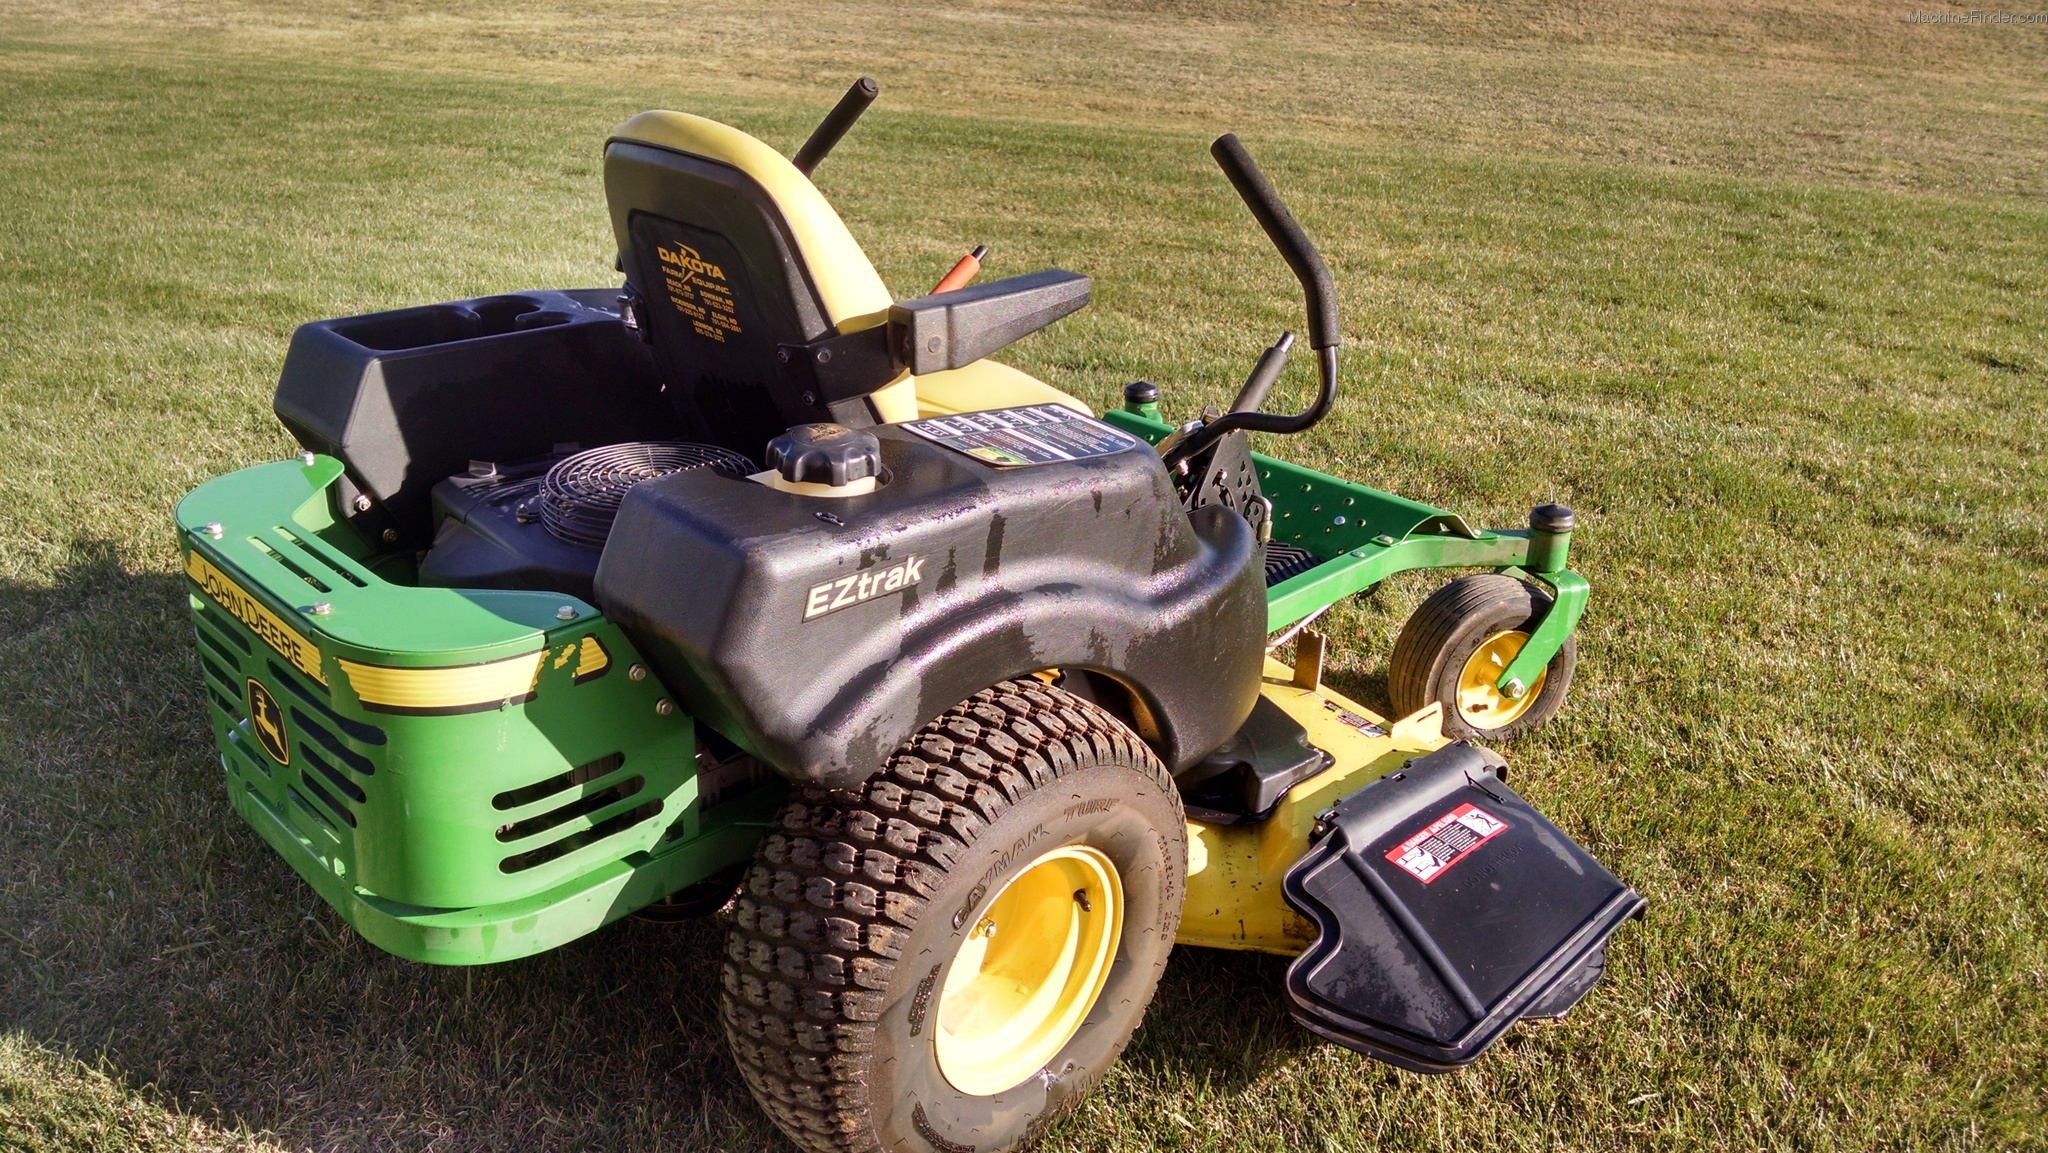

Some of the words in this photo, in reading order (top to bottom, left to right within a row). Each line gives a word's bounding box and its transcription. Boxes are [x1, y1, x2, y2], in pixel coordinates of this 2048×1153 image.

[657, 246, 726, 281] DAKOTA
[662, 265, 685, 279] FARM
[805, 556, 925, 618] EZtrak
[201, 564, 243, 620] JOHN
[245, 598, 305, 668] DEERE
[1064, 799, 1119, 822] TURF
[1405, 830, 1433, 850] DANGER
[952, 823, 1047, 930] CAYMAN
